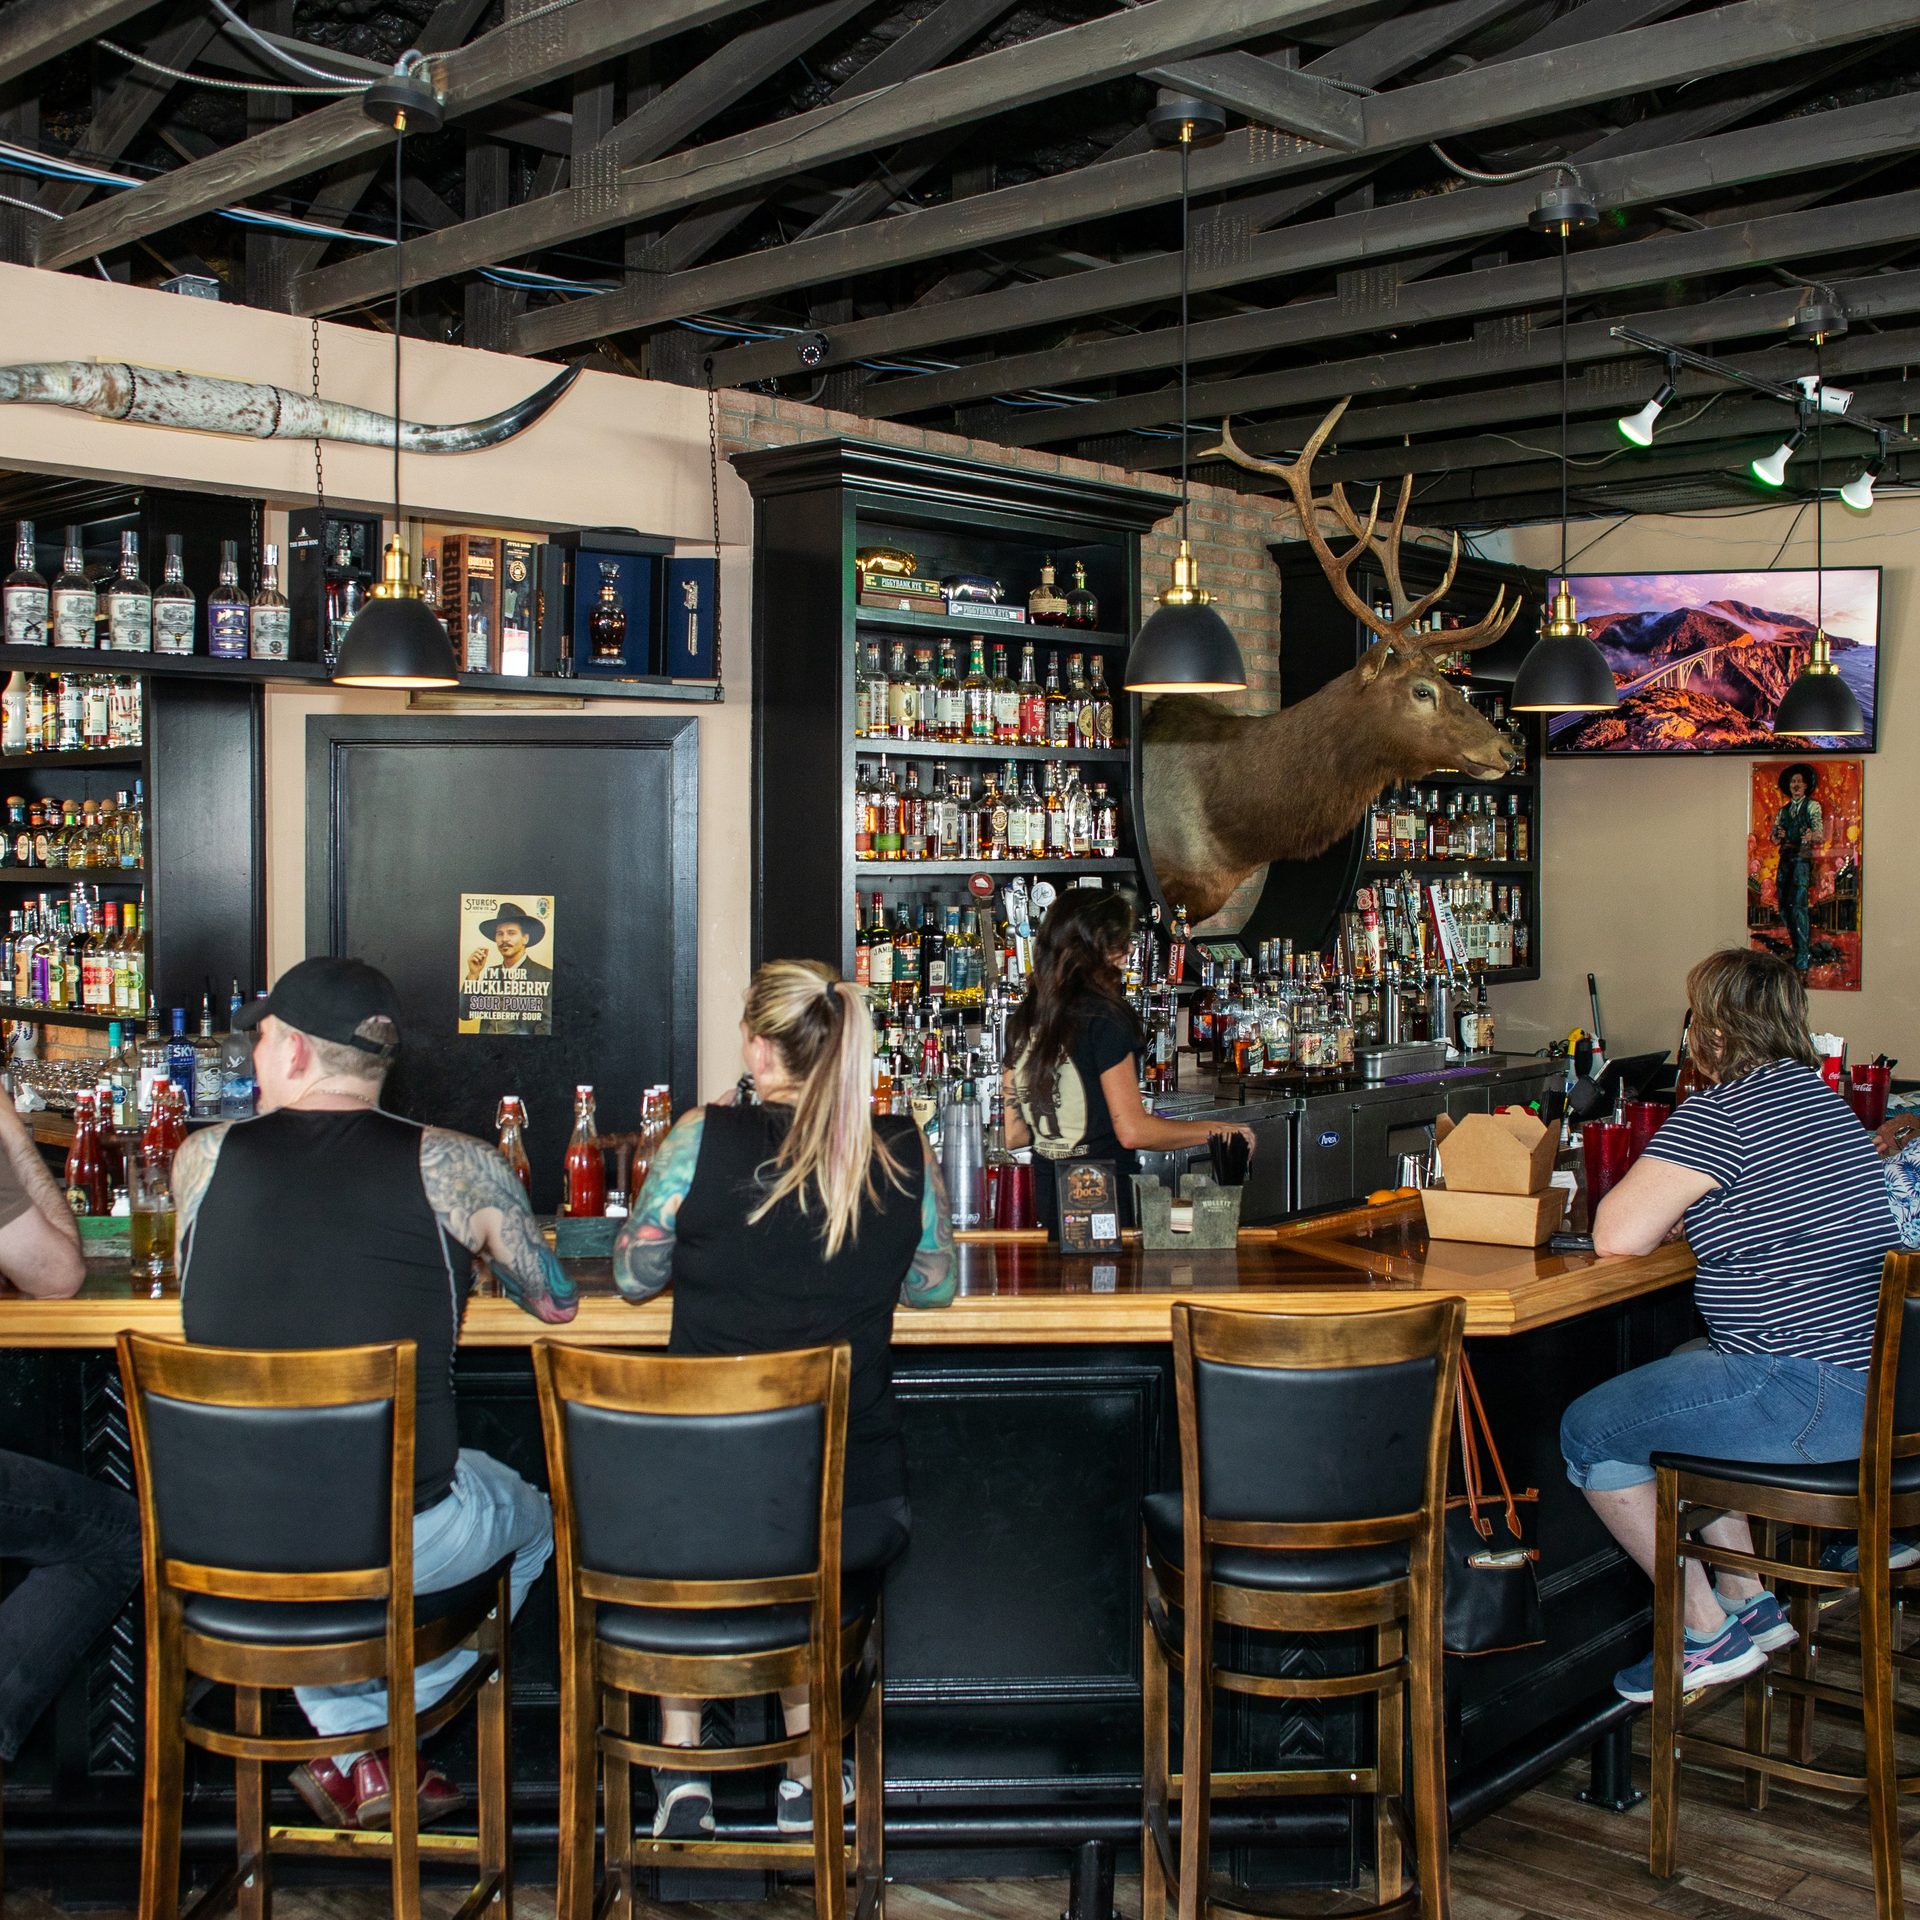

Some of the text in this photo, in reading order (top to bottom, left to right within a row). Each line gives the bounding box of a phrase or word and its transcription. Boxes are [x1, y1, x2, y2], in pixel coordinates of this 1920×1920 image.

[881, 577, 911, 588] PIGGYBANK
[963, 604, 997, 616] PIGGYBANK
[464, 898, 498, 912] STURGIS
[1168, 944, 1179, 976] OHSO
[484, 968, 528, 981] I'M YOUR
[463, 980, 550, 996] HUCKLEBERRY
[470, 996, 544, 1011] SOUR POWER
[469, 1011, 542, 1021] HUCKLEBERRY SOUR
